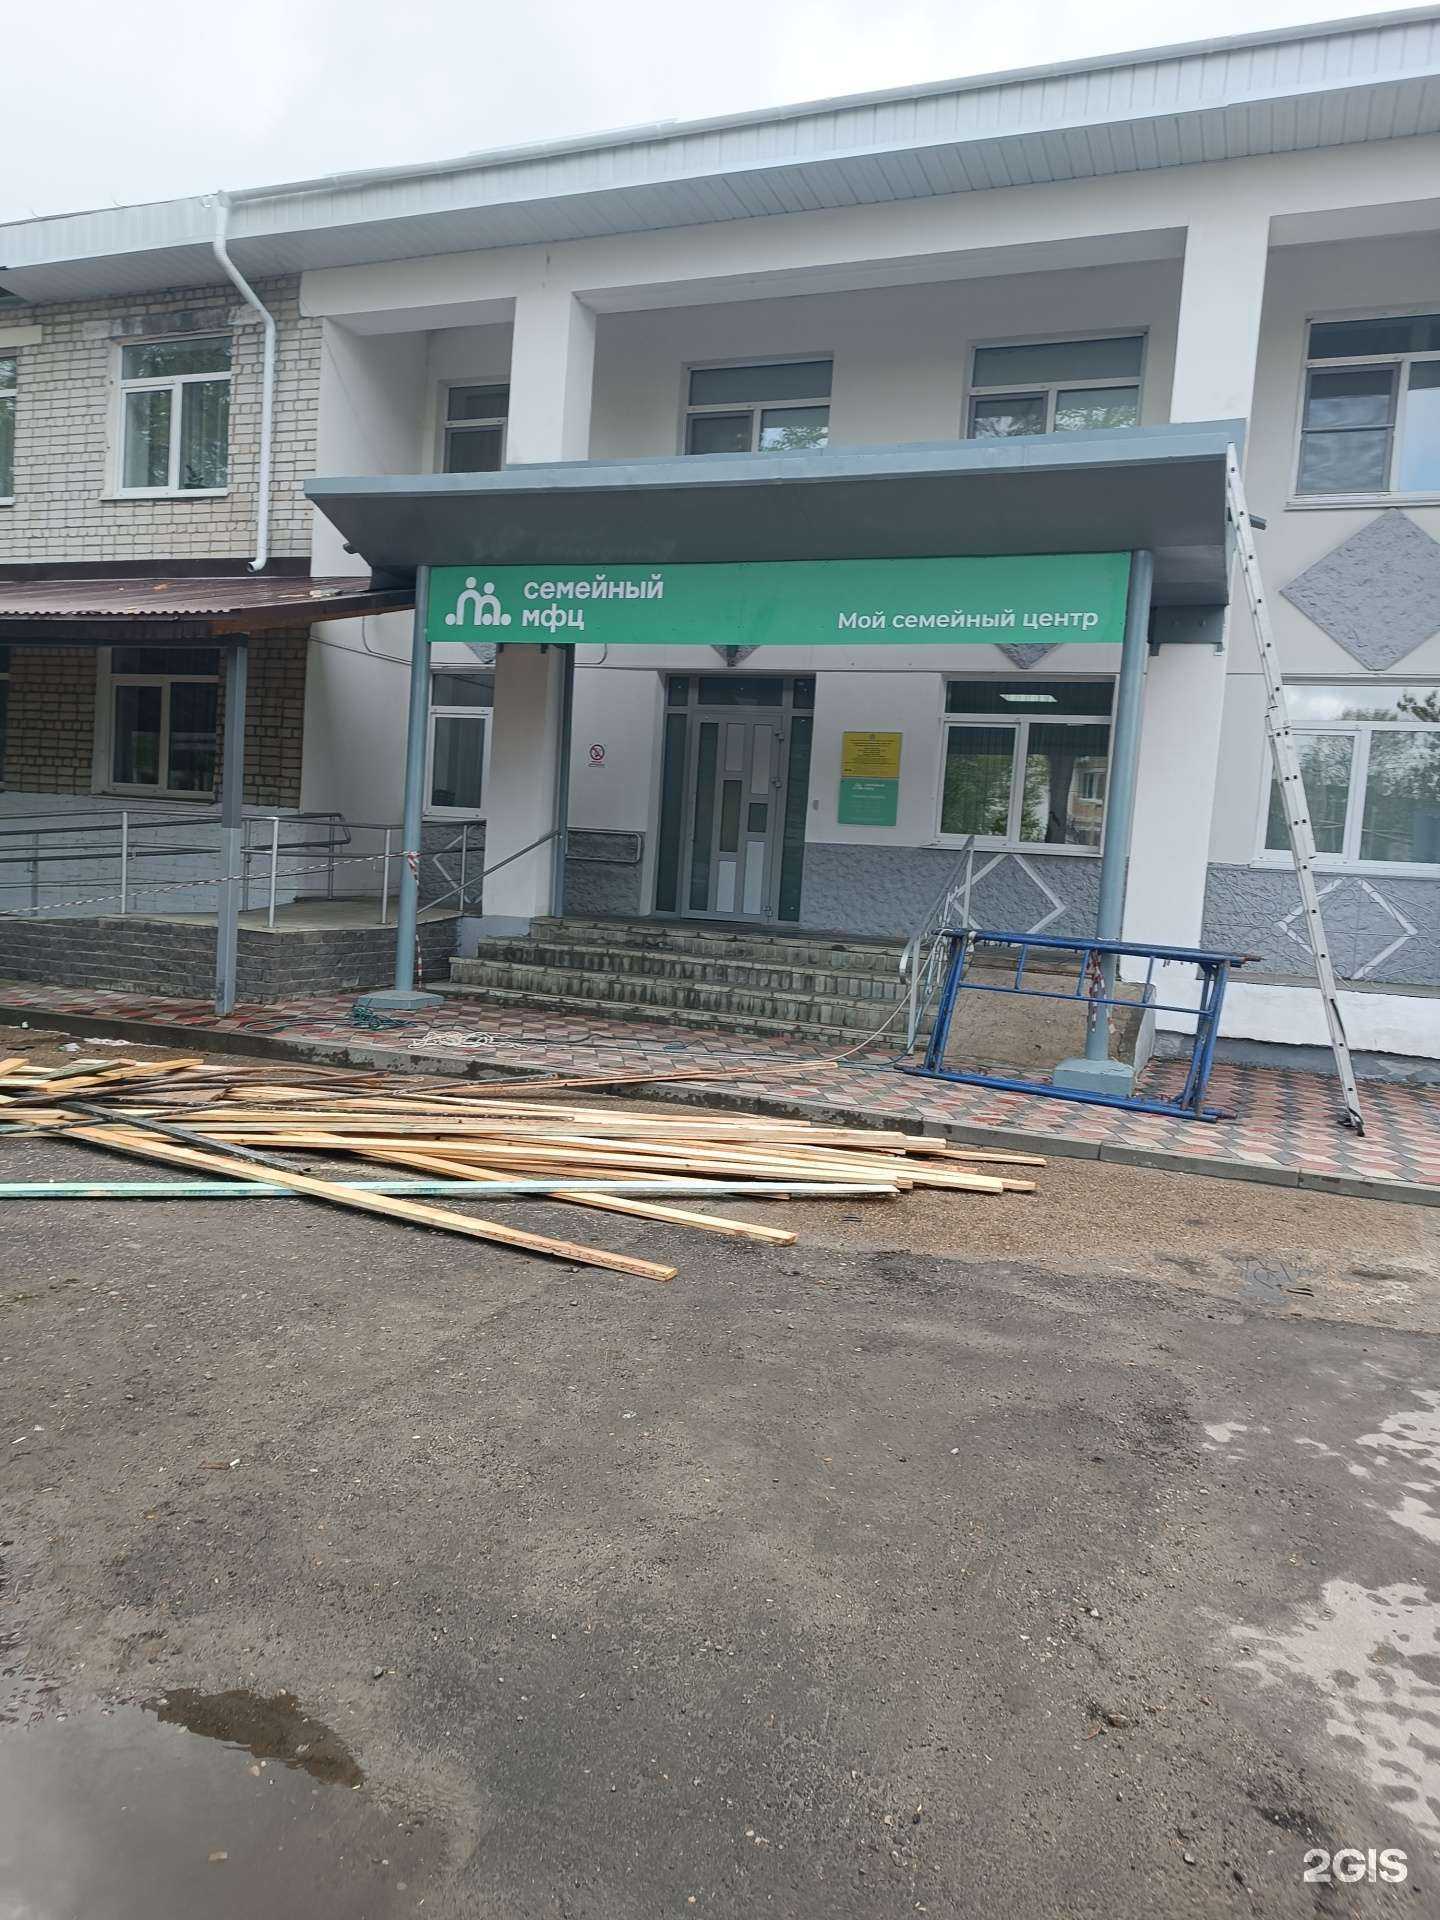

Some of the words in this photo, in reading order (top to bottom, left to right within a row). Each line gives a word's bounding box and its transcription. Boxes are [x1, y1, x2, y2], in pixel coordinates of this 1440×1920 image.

[523, 574, 664, 600] семейный
[522, 604, 585, 633] мфц
[838, 611, 886, 630] Мой
[892, 609, 1016, 629] семейный
[1022, 610, 1099, 631] центр
